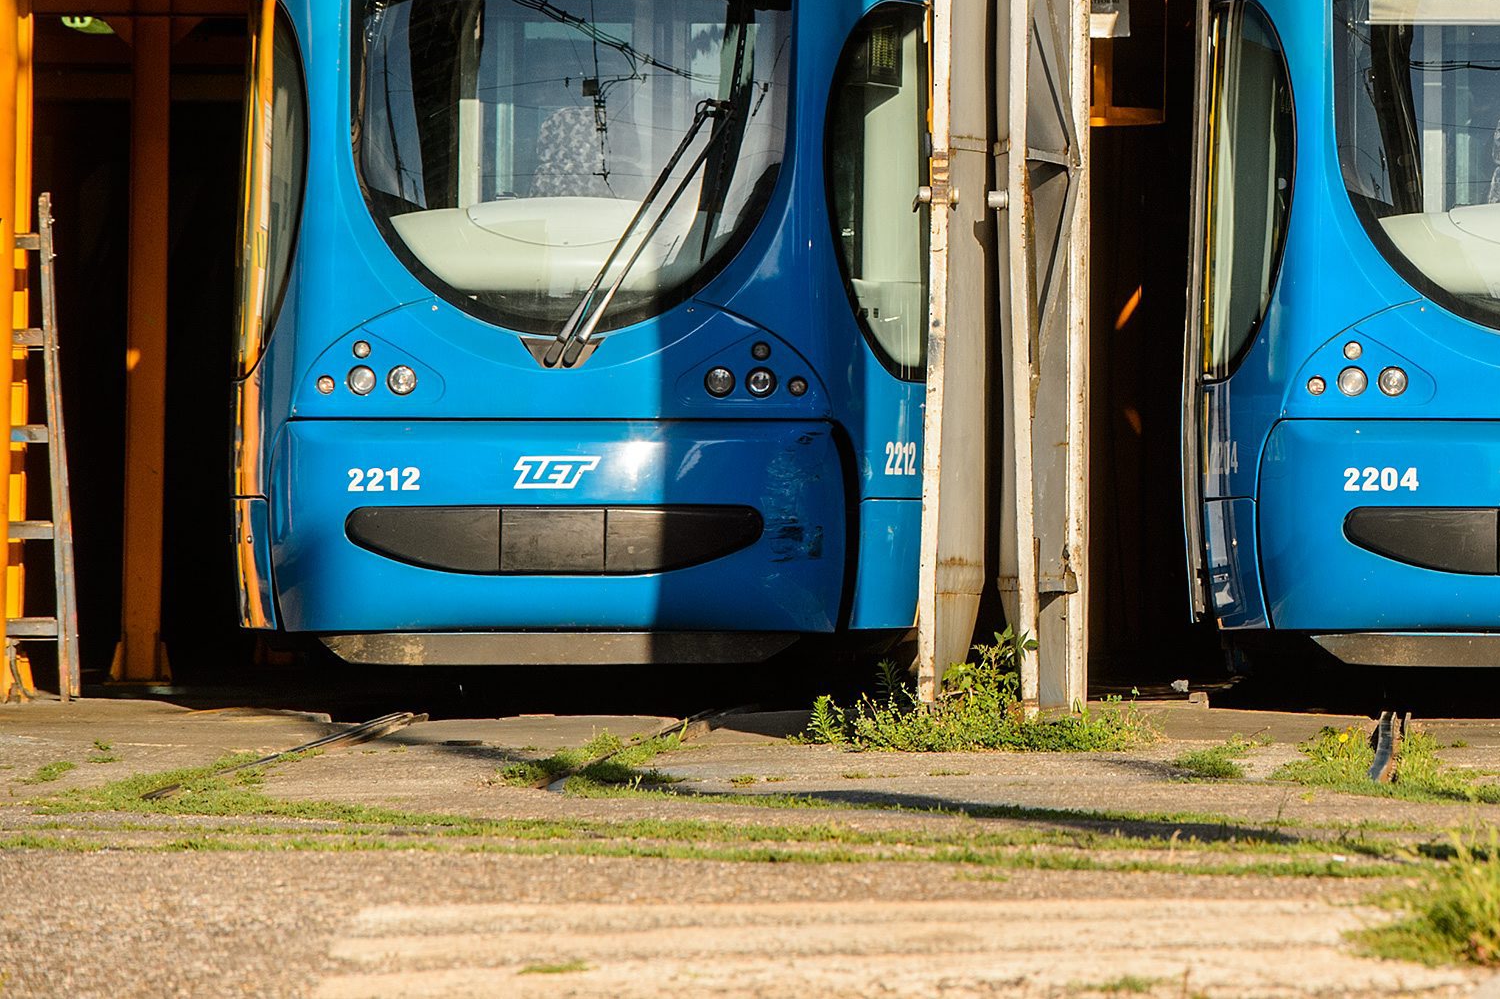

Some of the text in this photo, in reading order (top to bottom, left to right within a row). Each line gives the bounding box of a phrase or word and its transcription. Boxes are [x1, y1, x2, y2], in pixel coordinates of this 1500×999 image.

[513, 455, 602, 490] ZET
[884, 441, 917, 476] 2212
[347, 467, 421, 492] 2212
[1343, 467, 1420, 492] 2204
